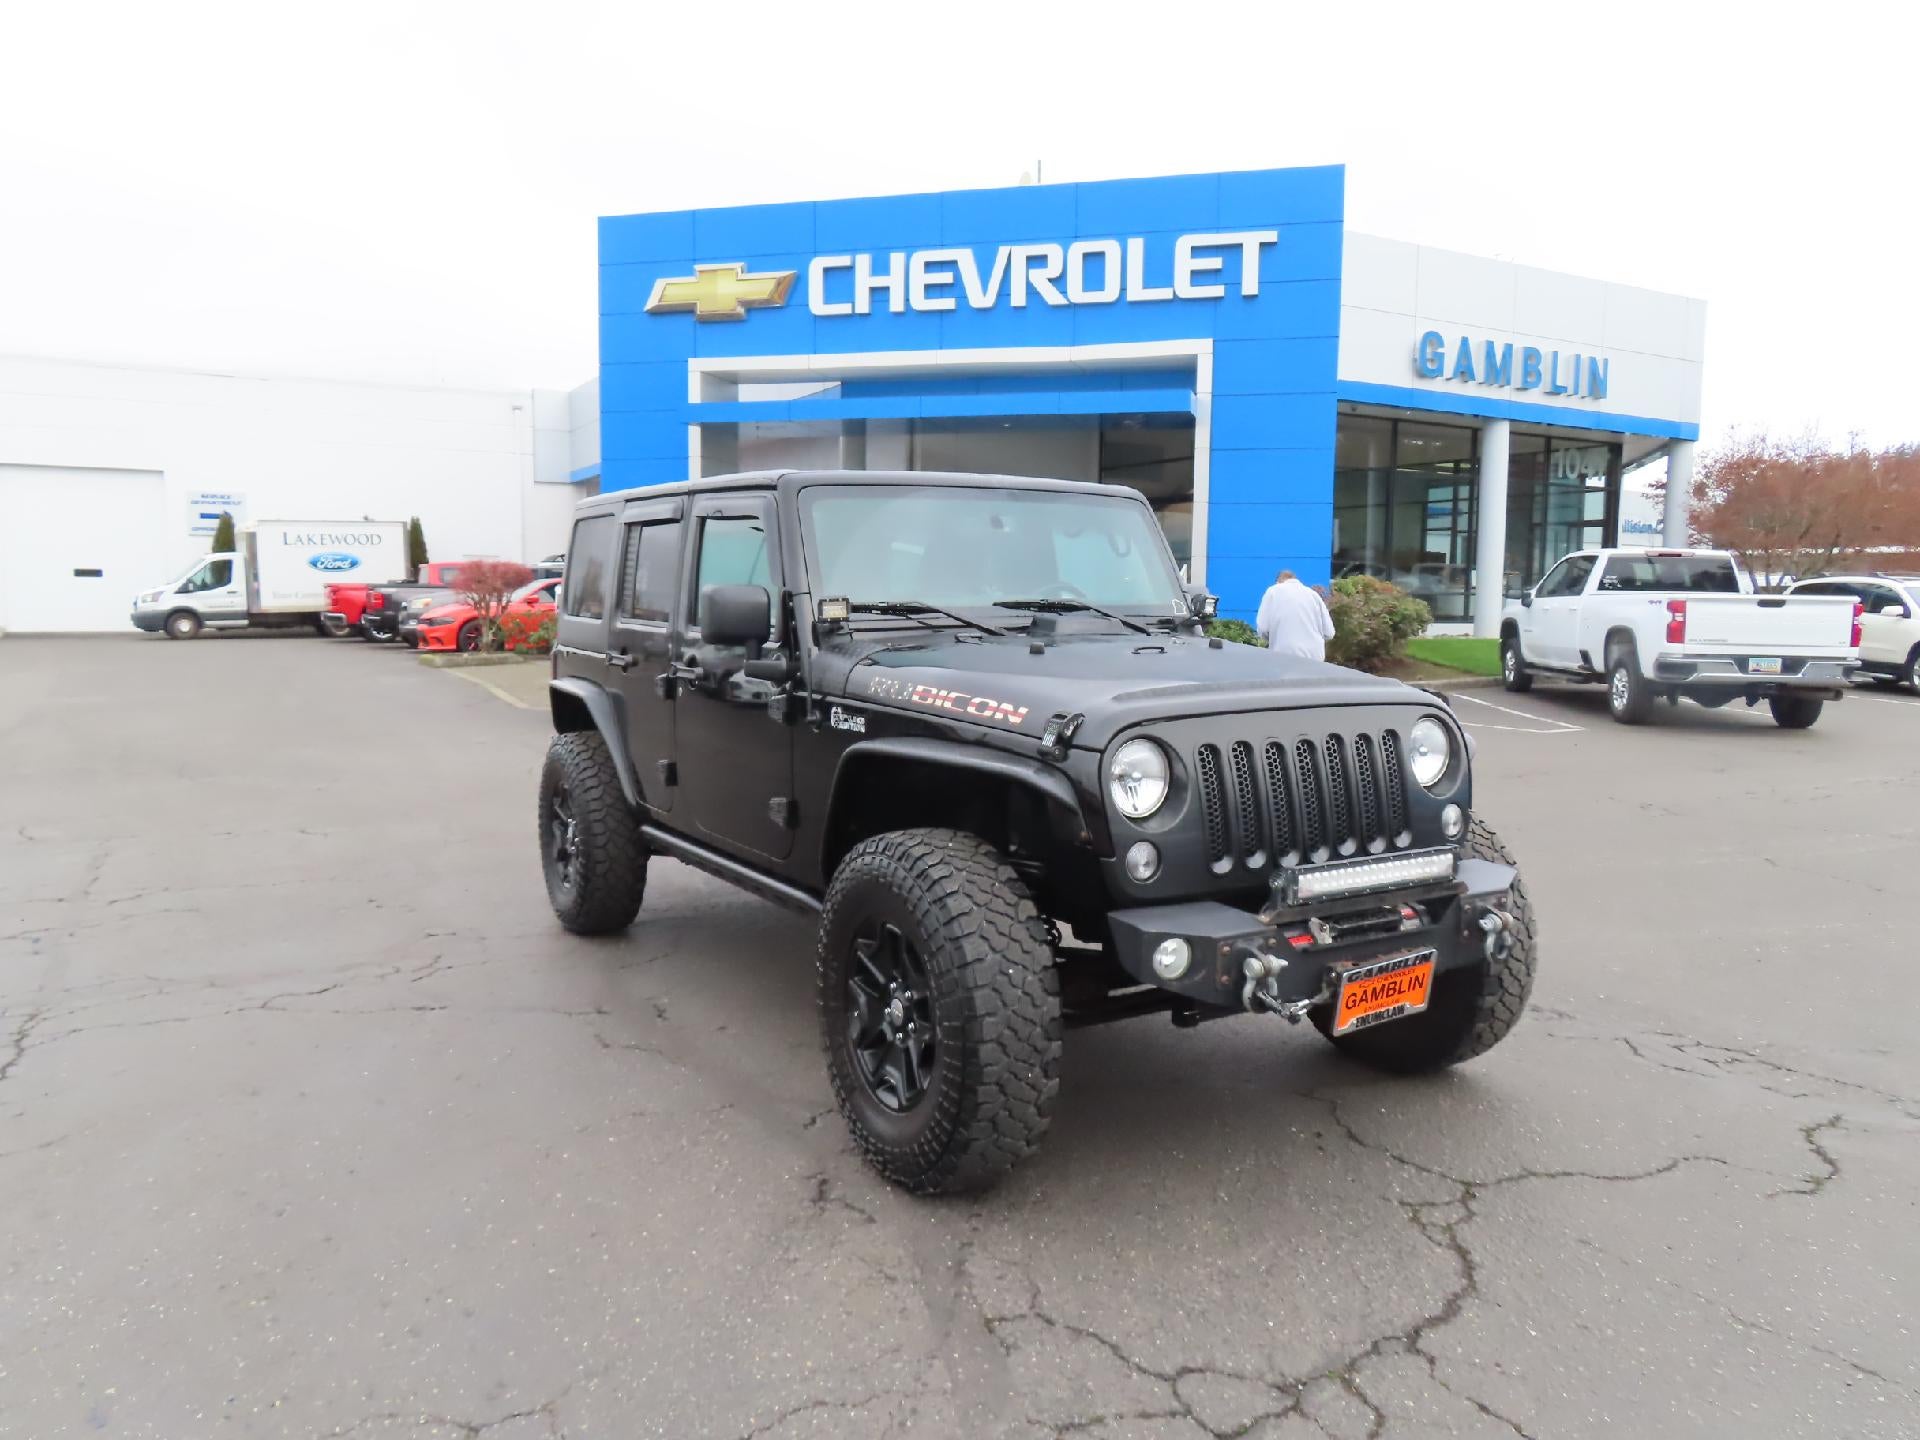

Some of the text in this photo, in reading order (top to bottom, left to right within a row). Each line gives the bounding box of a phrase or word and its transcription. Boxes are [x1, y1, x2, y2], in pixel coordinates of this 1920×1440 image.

[808, 231, 1278, 316] CHEVROLET
[1417, 330, 1608, 399] GAMBLIN
[283, 531, 382, 546] LAKEWOOD
[316, 554, 353, 569] Ford
[869, 676, 1029, 724] RUBICON
[1345, 972, 1426, 1010] GAMBLIN
[1356, 1004, 1406, 1029] ENUMCLAW
